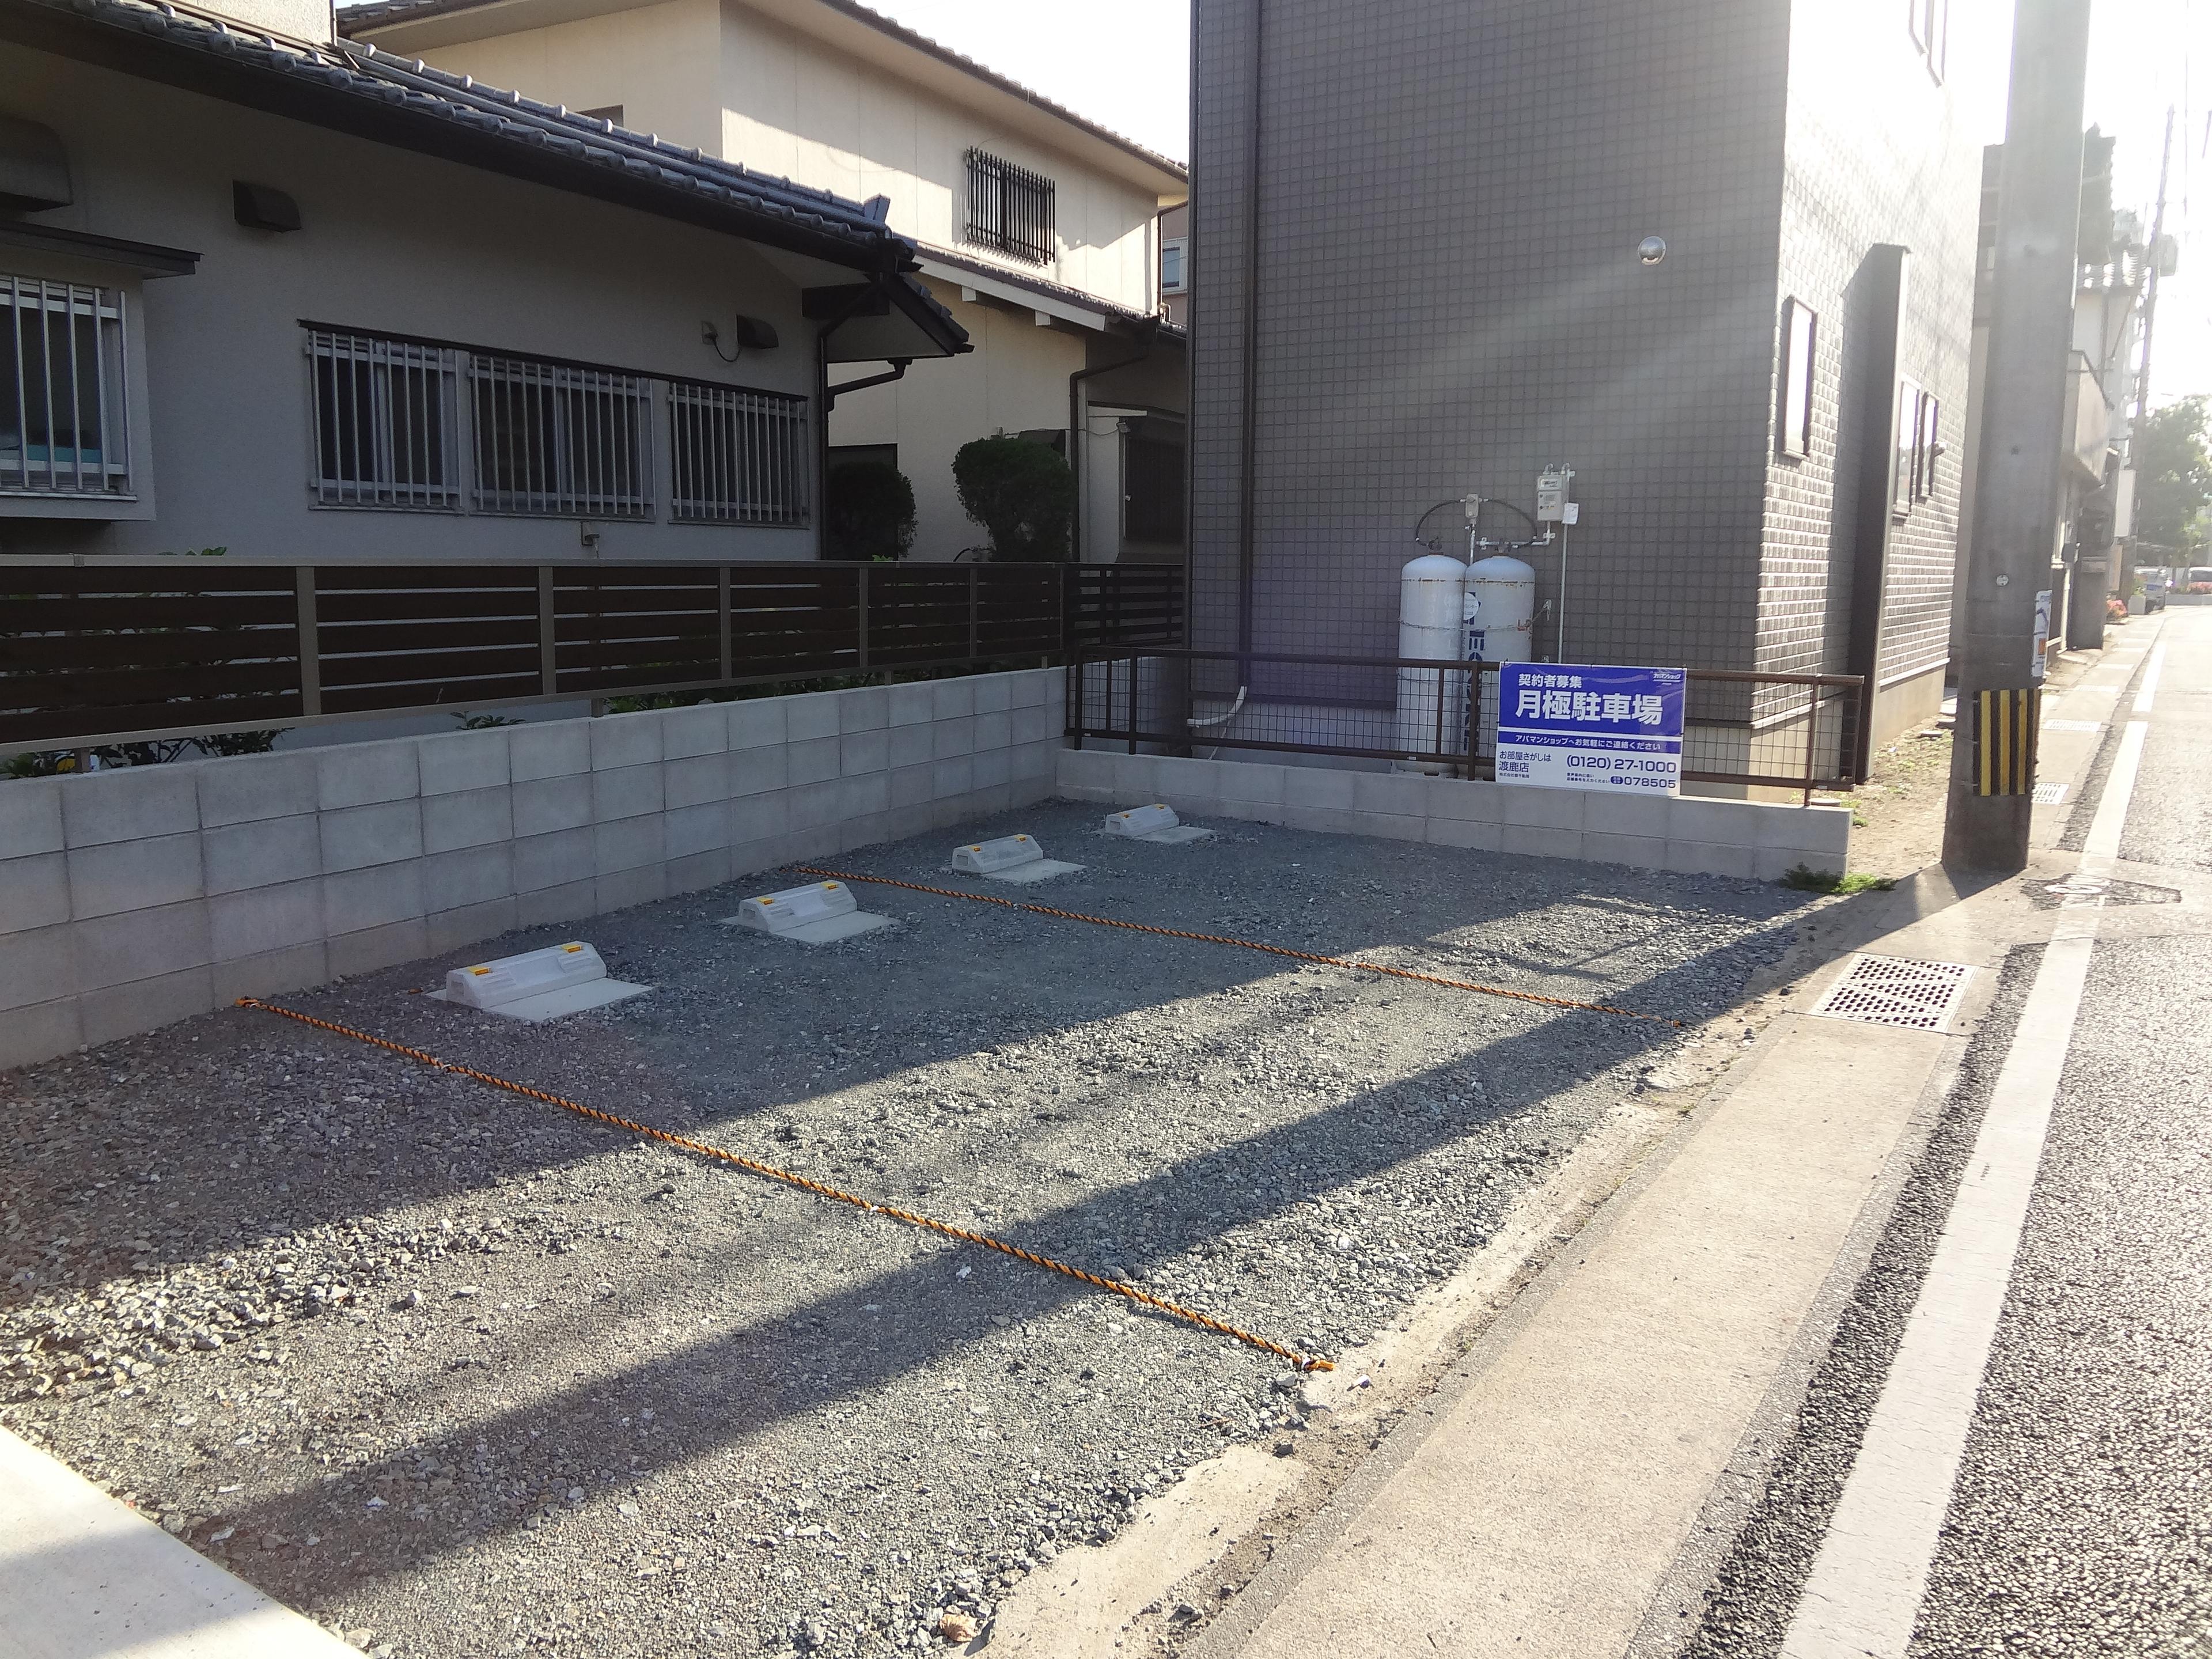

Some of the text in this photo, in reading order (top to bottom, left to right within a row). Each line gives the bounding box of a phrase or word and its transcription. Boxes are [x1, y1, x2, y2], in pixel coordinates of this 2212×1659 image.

[1518, 673, 1582, 688] 契約者募集
[1516, 690, 1663, 725] 月極駐車場
[1515, 734, 1661, 751] アパマンショップへお気軽にご連絡ください
[1499, 751, 1551, 762] お部屋さがしは
[1498, 760, 1529, 773] 渡鹿店
[1624, 776, 1676, 789] 078505
